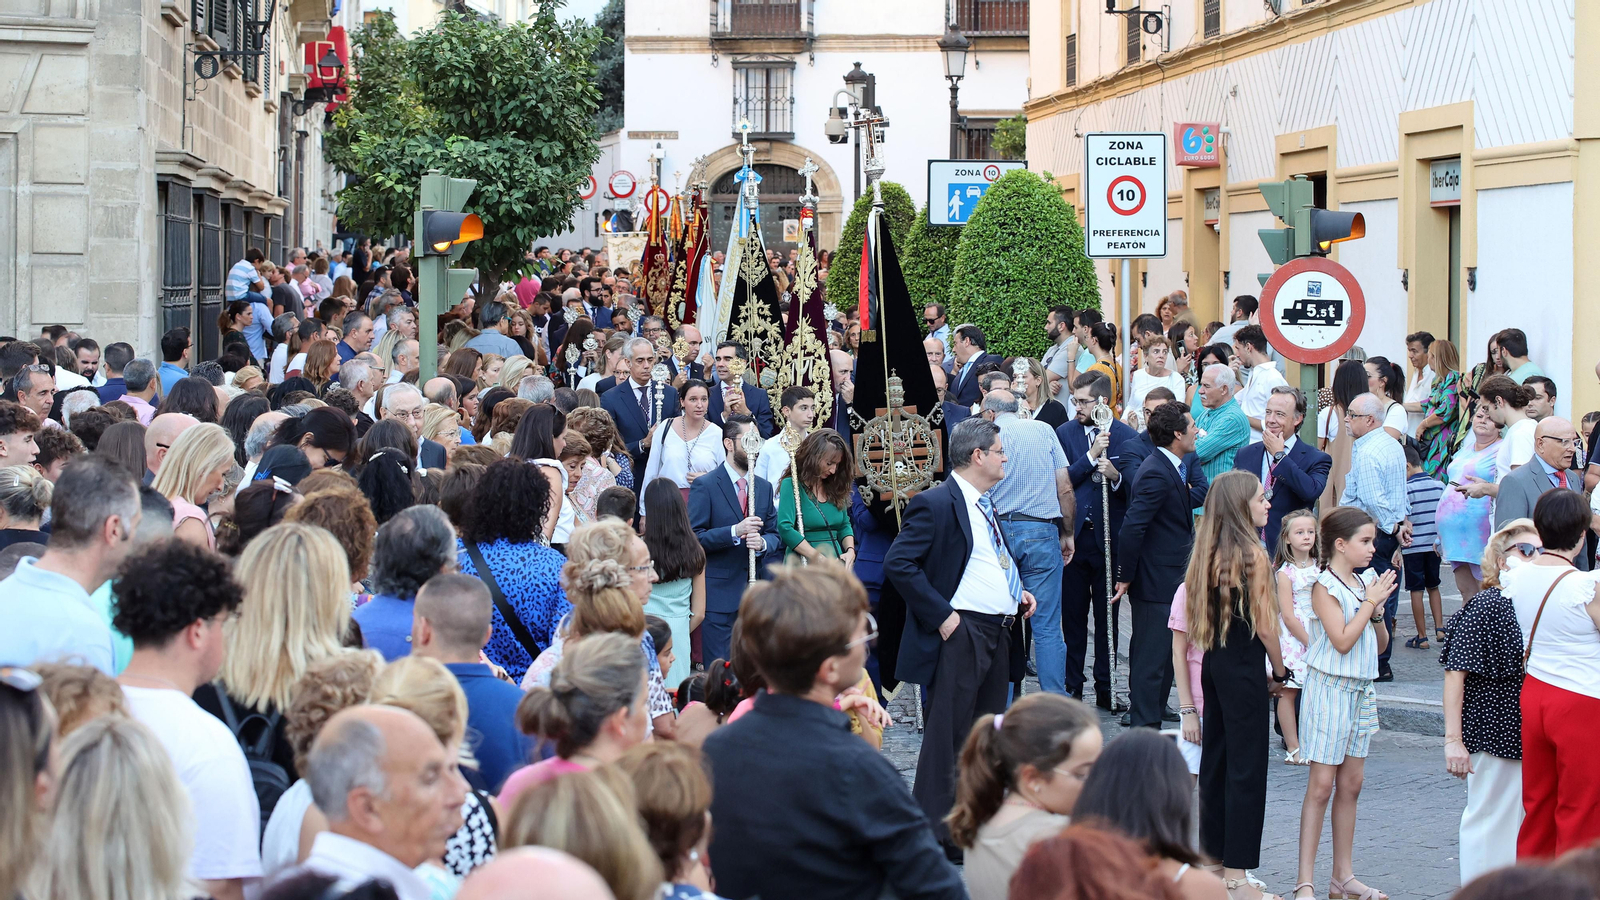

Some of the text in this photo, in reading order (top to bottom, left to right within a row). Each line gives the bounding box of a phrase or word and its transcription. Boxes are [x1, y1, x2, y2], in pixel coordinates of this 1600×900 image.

[1108, 141, 1143, 150] ZONA
[1095, 157, 1157, 166] CICLABLE
[1432, 169, 1460, 191] iberCaja
[1117, 189, 1135, 201] 10
[1092, 229, 1160, 237] PREFERENCIA
[1107, 240, 1146, 249] PEATÓN
